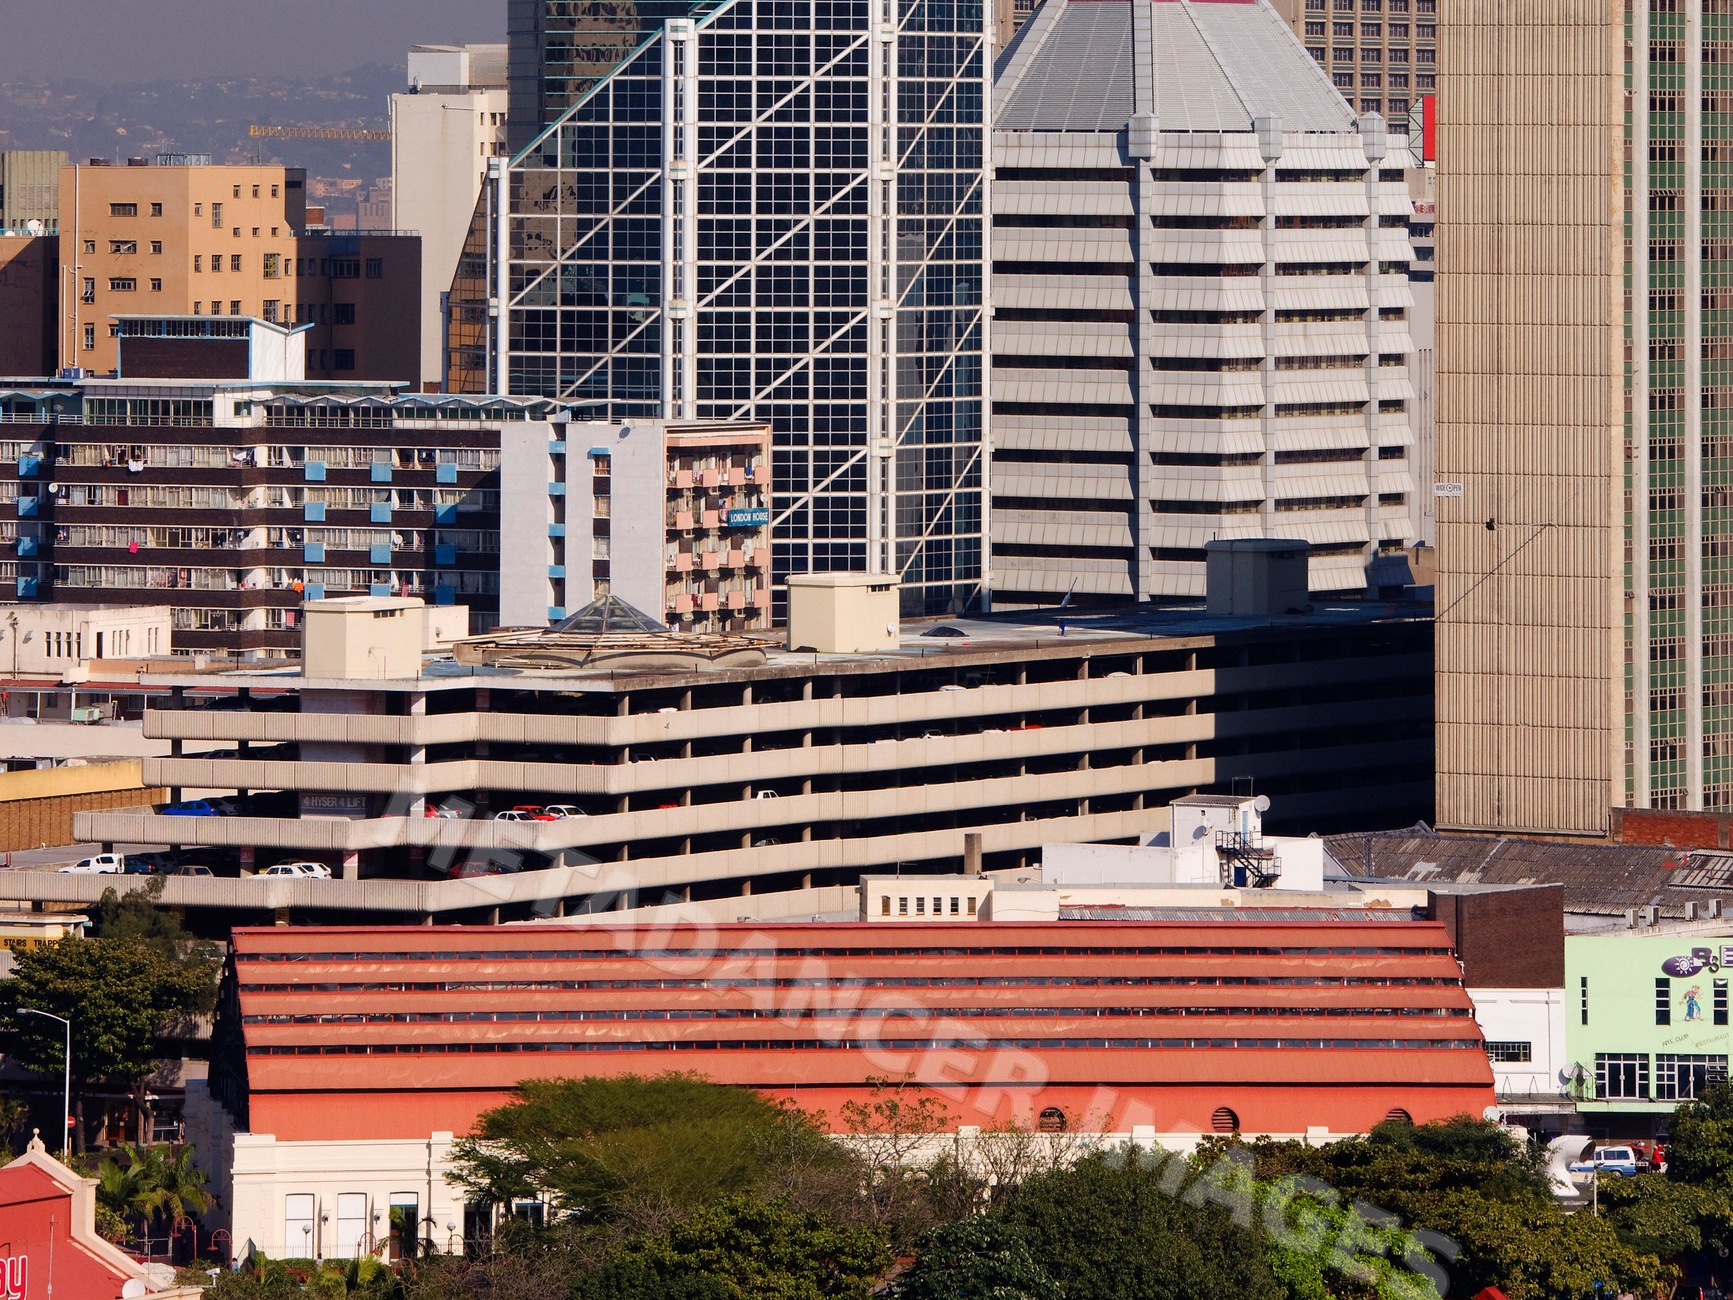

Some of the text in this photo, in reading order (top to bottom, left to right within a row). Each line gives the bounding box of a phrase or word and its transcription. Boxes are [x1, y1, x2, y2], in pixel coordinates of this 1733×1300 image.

[731, 512, 768, 522] LONDON HOUSE
[304, 797, 366, 807] 4 HYSER 4 LIFT
